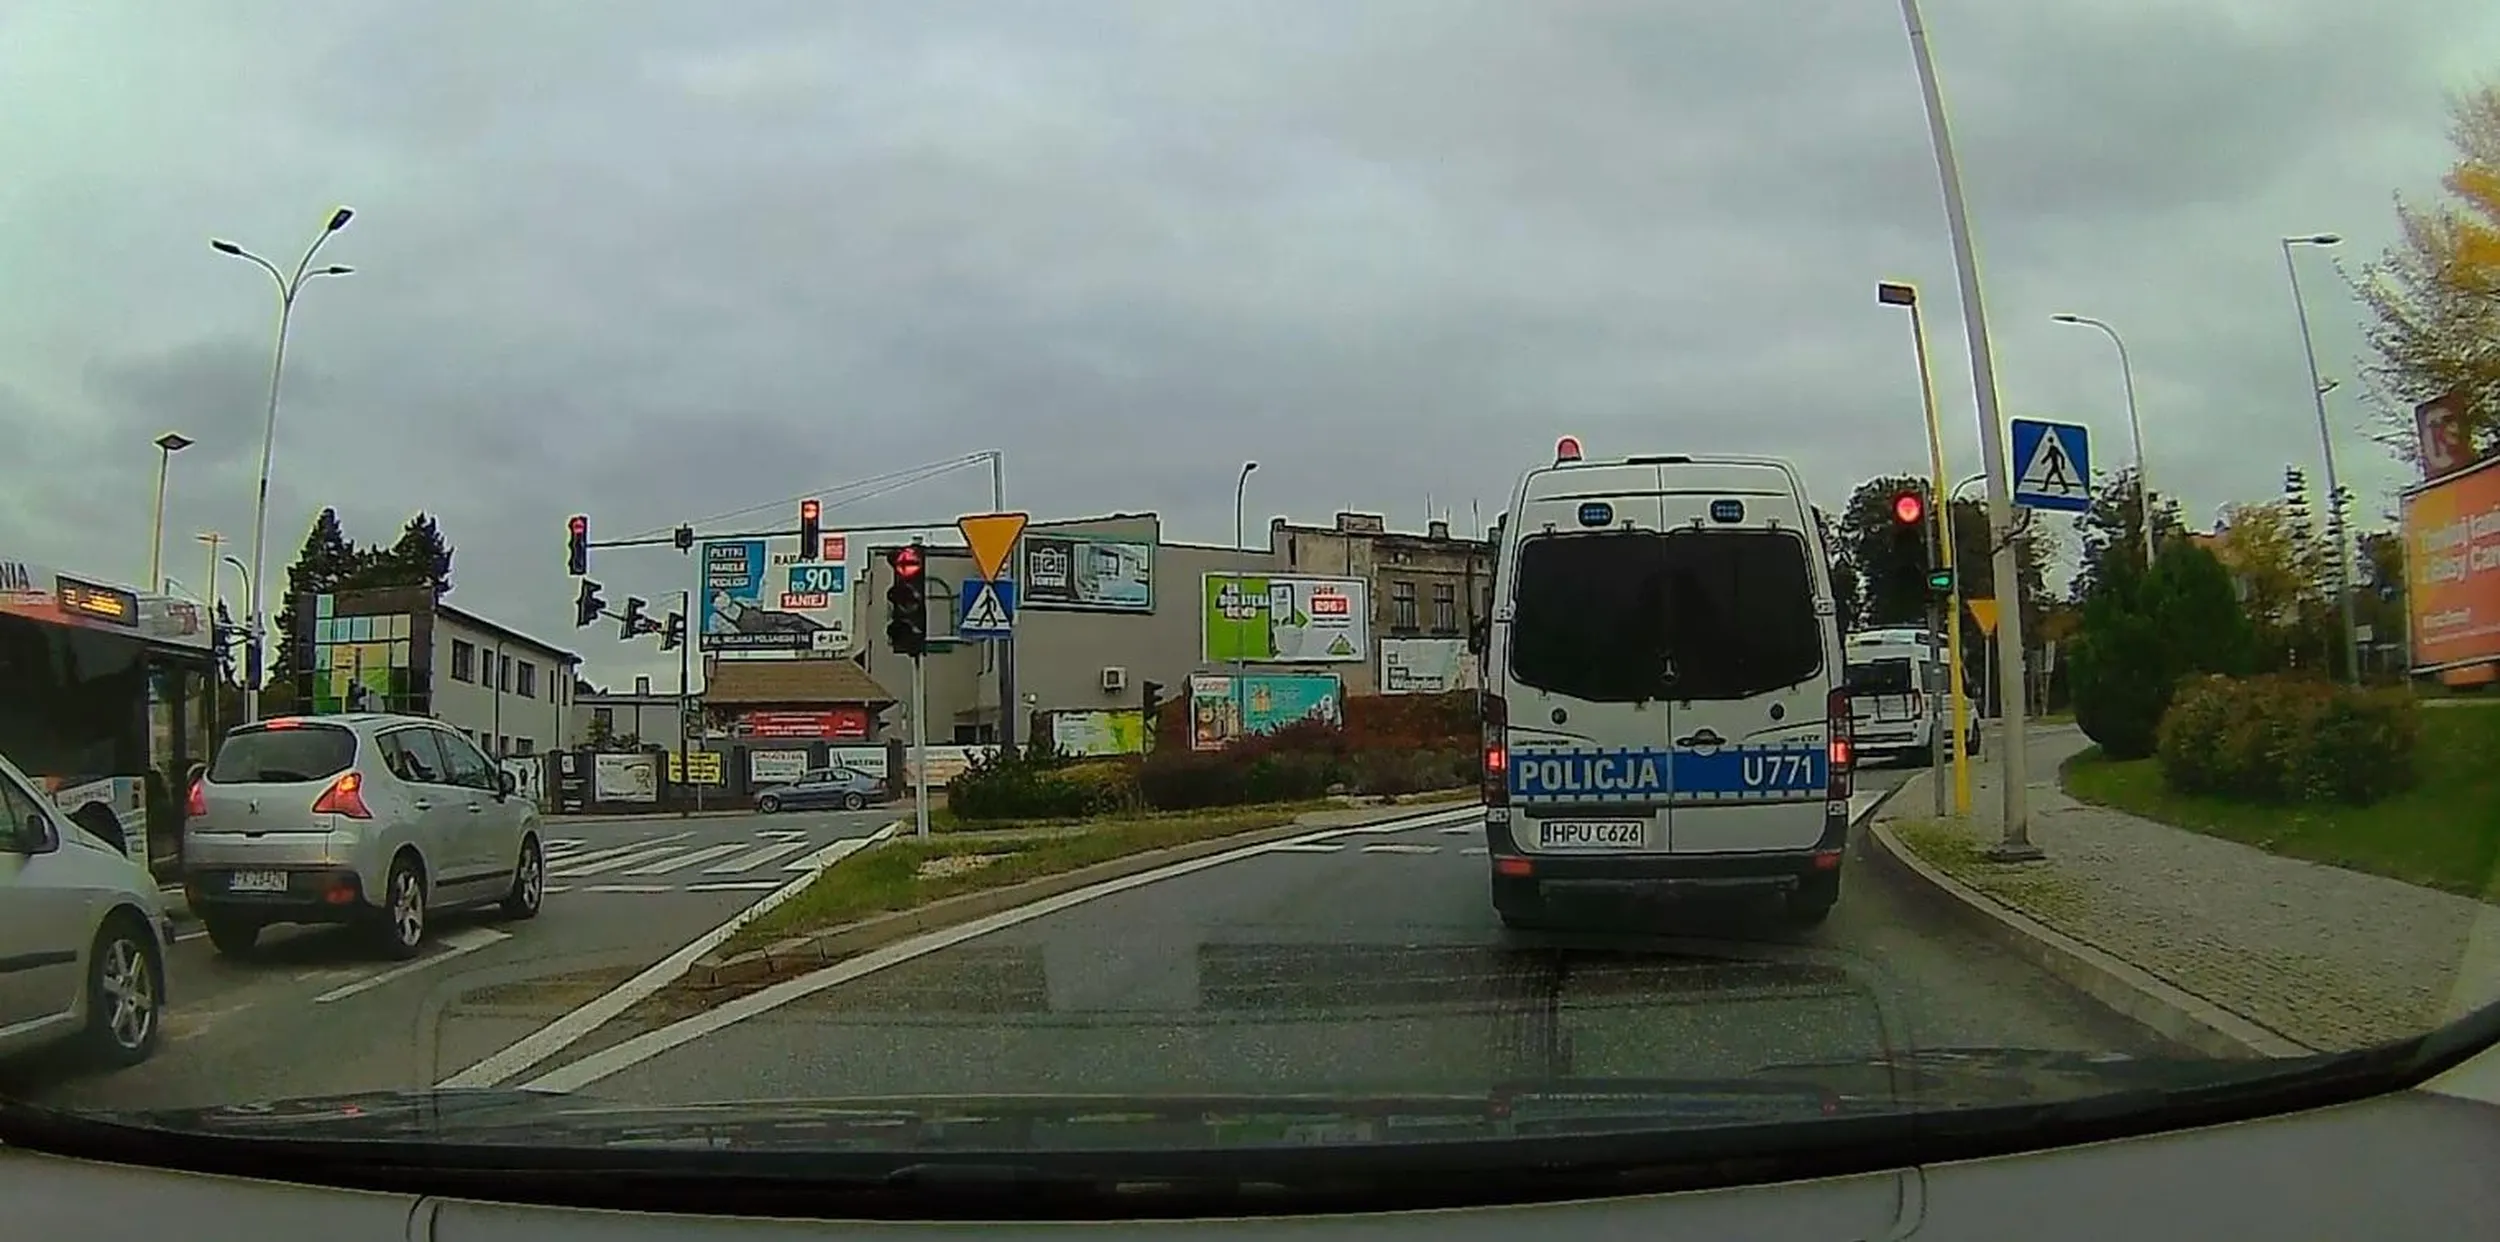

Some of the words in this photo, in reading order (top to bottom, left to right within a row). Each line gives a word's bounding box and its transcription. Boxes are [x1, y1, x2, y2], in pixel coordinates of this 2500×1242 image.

[783, 594, 825, 606] TANIEJ
[1519, 759, 1660, 790] POLICJA
[1743, 756, 1812, 786] U771
[1553, 825, 1592, 843] HPU
[1596, 825, 1640, 842] C626
